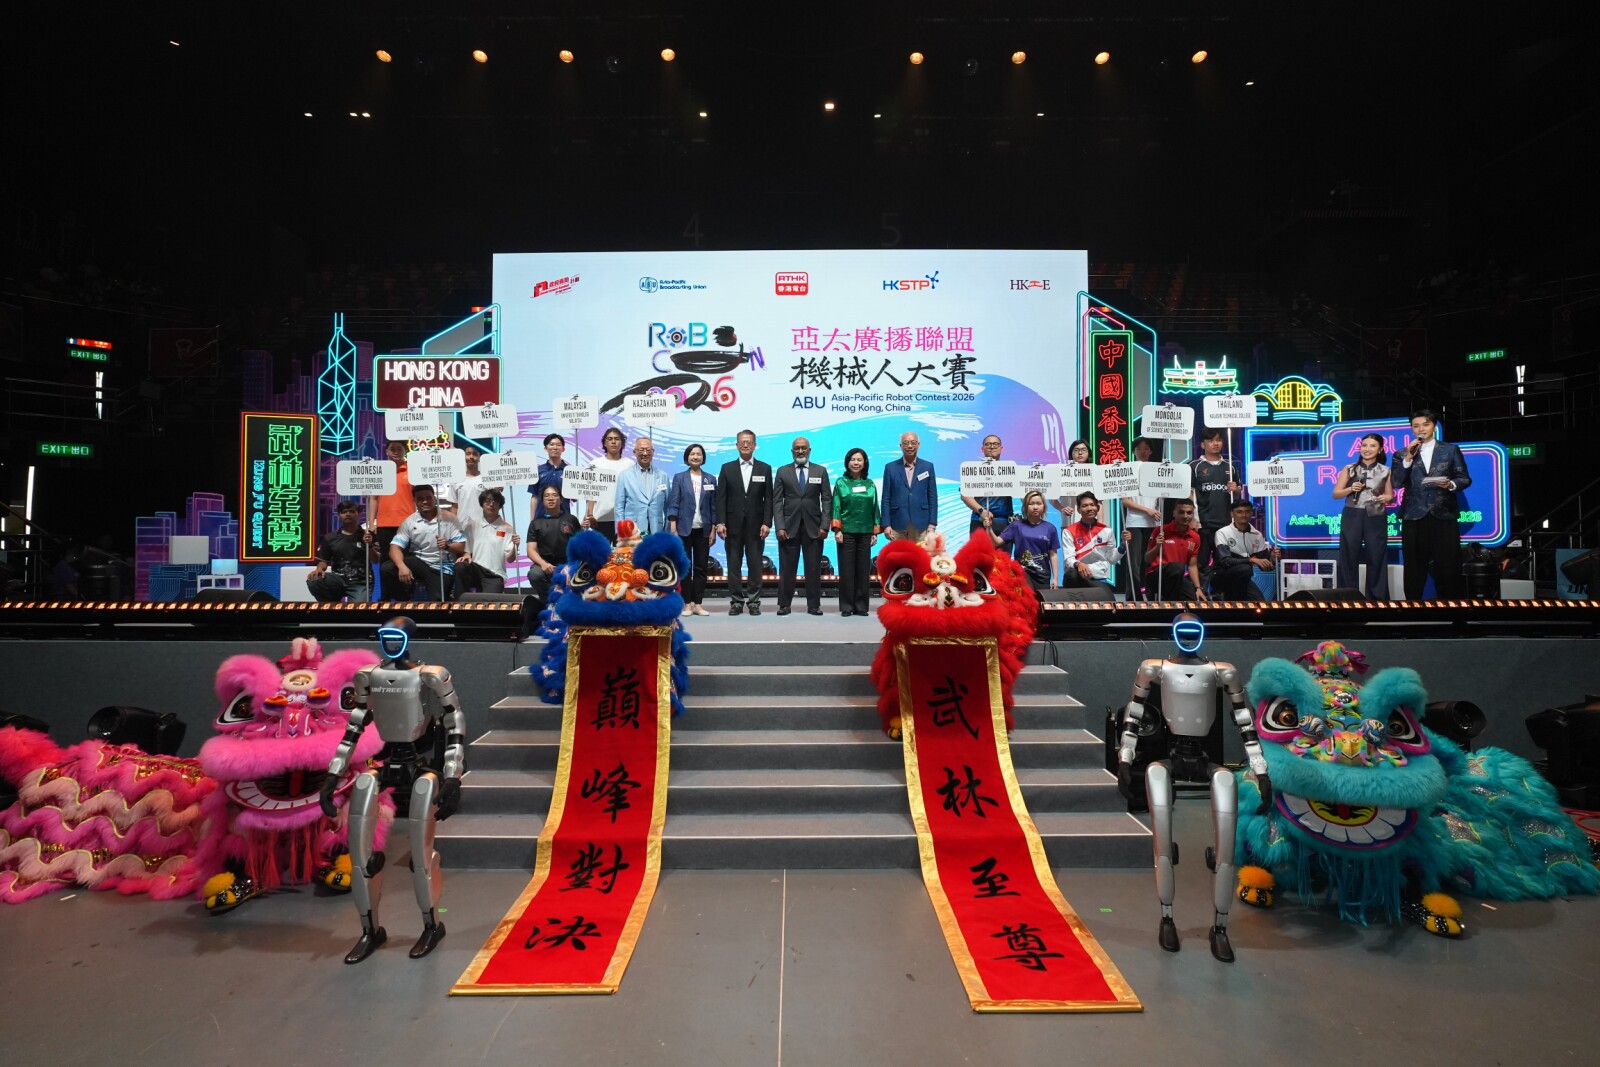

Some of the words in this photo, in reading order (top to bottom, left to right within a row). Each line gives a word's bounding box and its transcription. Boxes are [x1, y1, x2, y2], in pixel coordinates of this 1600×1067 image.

[882, 279, 930, 291] HKSTP
[790, 326, 976, 352] 亞太廣播聯盟
[71, 350, 91, 359] EXIT
[93, 353, 106, 361] 出口
[1469, 352, 1488, 361] EXIT
[1490, 350, 1504, 359] 出口
[384, 360, 435, 381] HONG
[438, 360, 490, 380] KONG
[789, 353, 977, 391] 機械人大賽
[408, 387, 465, 407] CHINA
[831, 393, 884, 402] Asia-Pacific
[886, 393, 914, 401] Robot
[915, 393, 950, 401] Contest
[952, 393, 975, 401] 2026
[1098, 339, 1127, 465] 中國香港
[563, 401, 587, 410] MALAYSIA
[633, 399, 667, 408] KAZAKHSTAN
[791, 396, 826, 409] ABU
[1217, 399, 1243, 408] THAILAND
[831, 404, 856, 413] Hong
[858, 404, 884, 413] Kong,
[887, 403, 911, 412] China
[400, 412, 424, 421] VIETNAM
[481, 410, 498, 419] NEPAL
[1155, 410, 1182, 420] MONGOLIA
[41, 444, 69, 454] EXIT
[71, 446, 89, 456] 出口
[1513, 446, 1531, 456] 出口
[431, 455, 442, 464] FIJI
[500, 457, 518, 466] CHINA
[350, 465, 382, 475] INDONESIA
[961, 466, 977, 476] HONG
[979, 466, 997, 476] KONG,
[998, 466, 1016, 476] CHINA
[1028, 470, 1044, 479] JAPAN
[1074, 468, 1091, 477] CHINA
[1104, 467, 1134, 478] CAMBODIA
[1157, 467, 1174, 477] EGYPT
[1268, 465, 1284, 475] INDIA
[564, 470, 580, 480] HONG
[581, 471, 598, 482] KONG,
[599, 473, 616, 483] CHINA
[252, 512, 264, 549] QUEST
[926, 674, 1064, 971] 武林至尊
